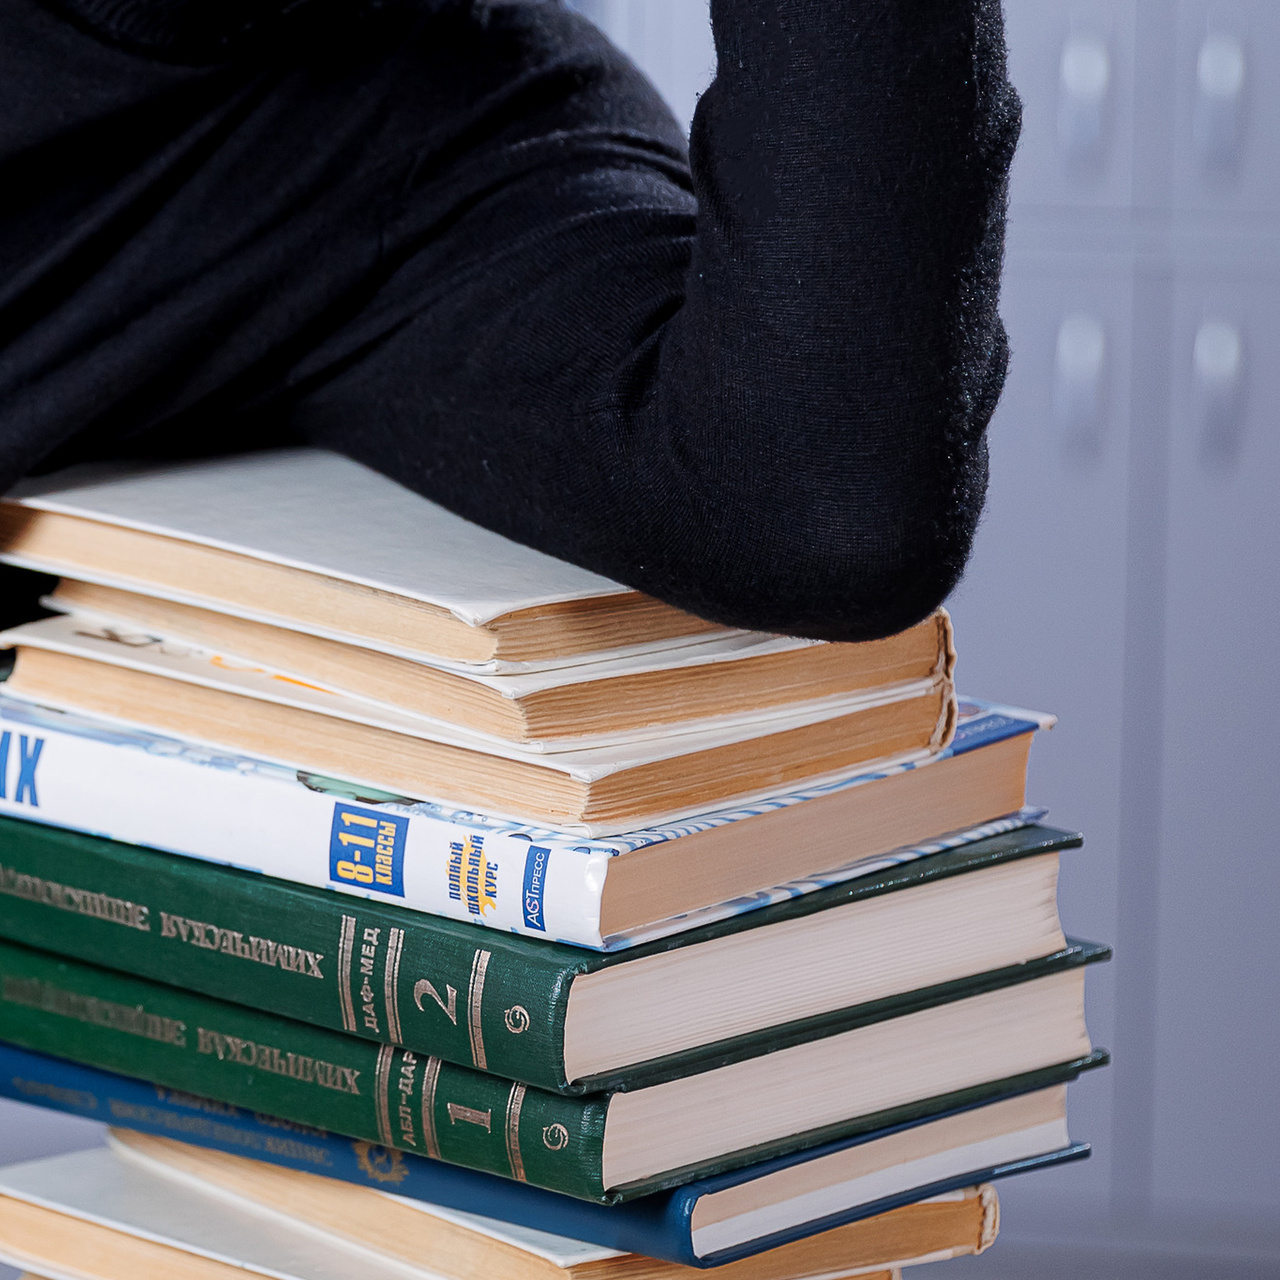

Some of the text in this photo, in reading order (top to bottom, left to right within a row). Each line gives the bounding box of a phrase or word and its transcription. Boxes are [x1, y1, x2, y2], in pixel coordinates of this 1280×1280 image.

[336, 812, 378, 884] 8-11
[448, 841, 464, 901] ПОЛНЫЙ
[466, 834, 484, 916] ШКОЛЬНЫЙ
[485, 861, 498, 899] КУРС
[160, 911, 324, 979] ХИМИЧЕСКАЯ
[360, 927, 382, 1034] ДАФ-МЕД
[413, 978, 458, 1026] 2
[196, 1027, 362, 1095] ХИМИЧЕСКАЯ
[398, 1051, 418, 1147] АБЛ-ДАР
[447, 1102, 492, 1134] 1
